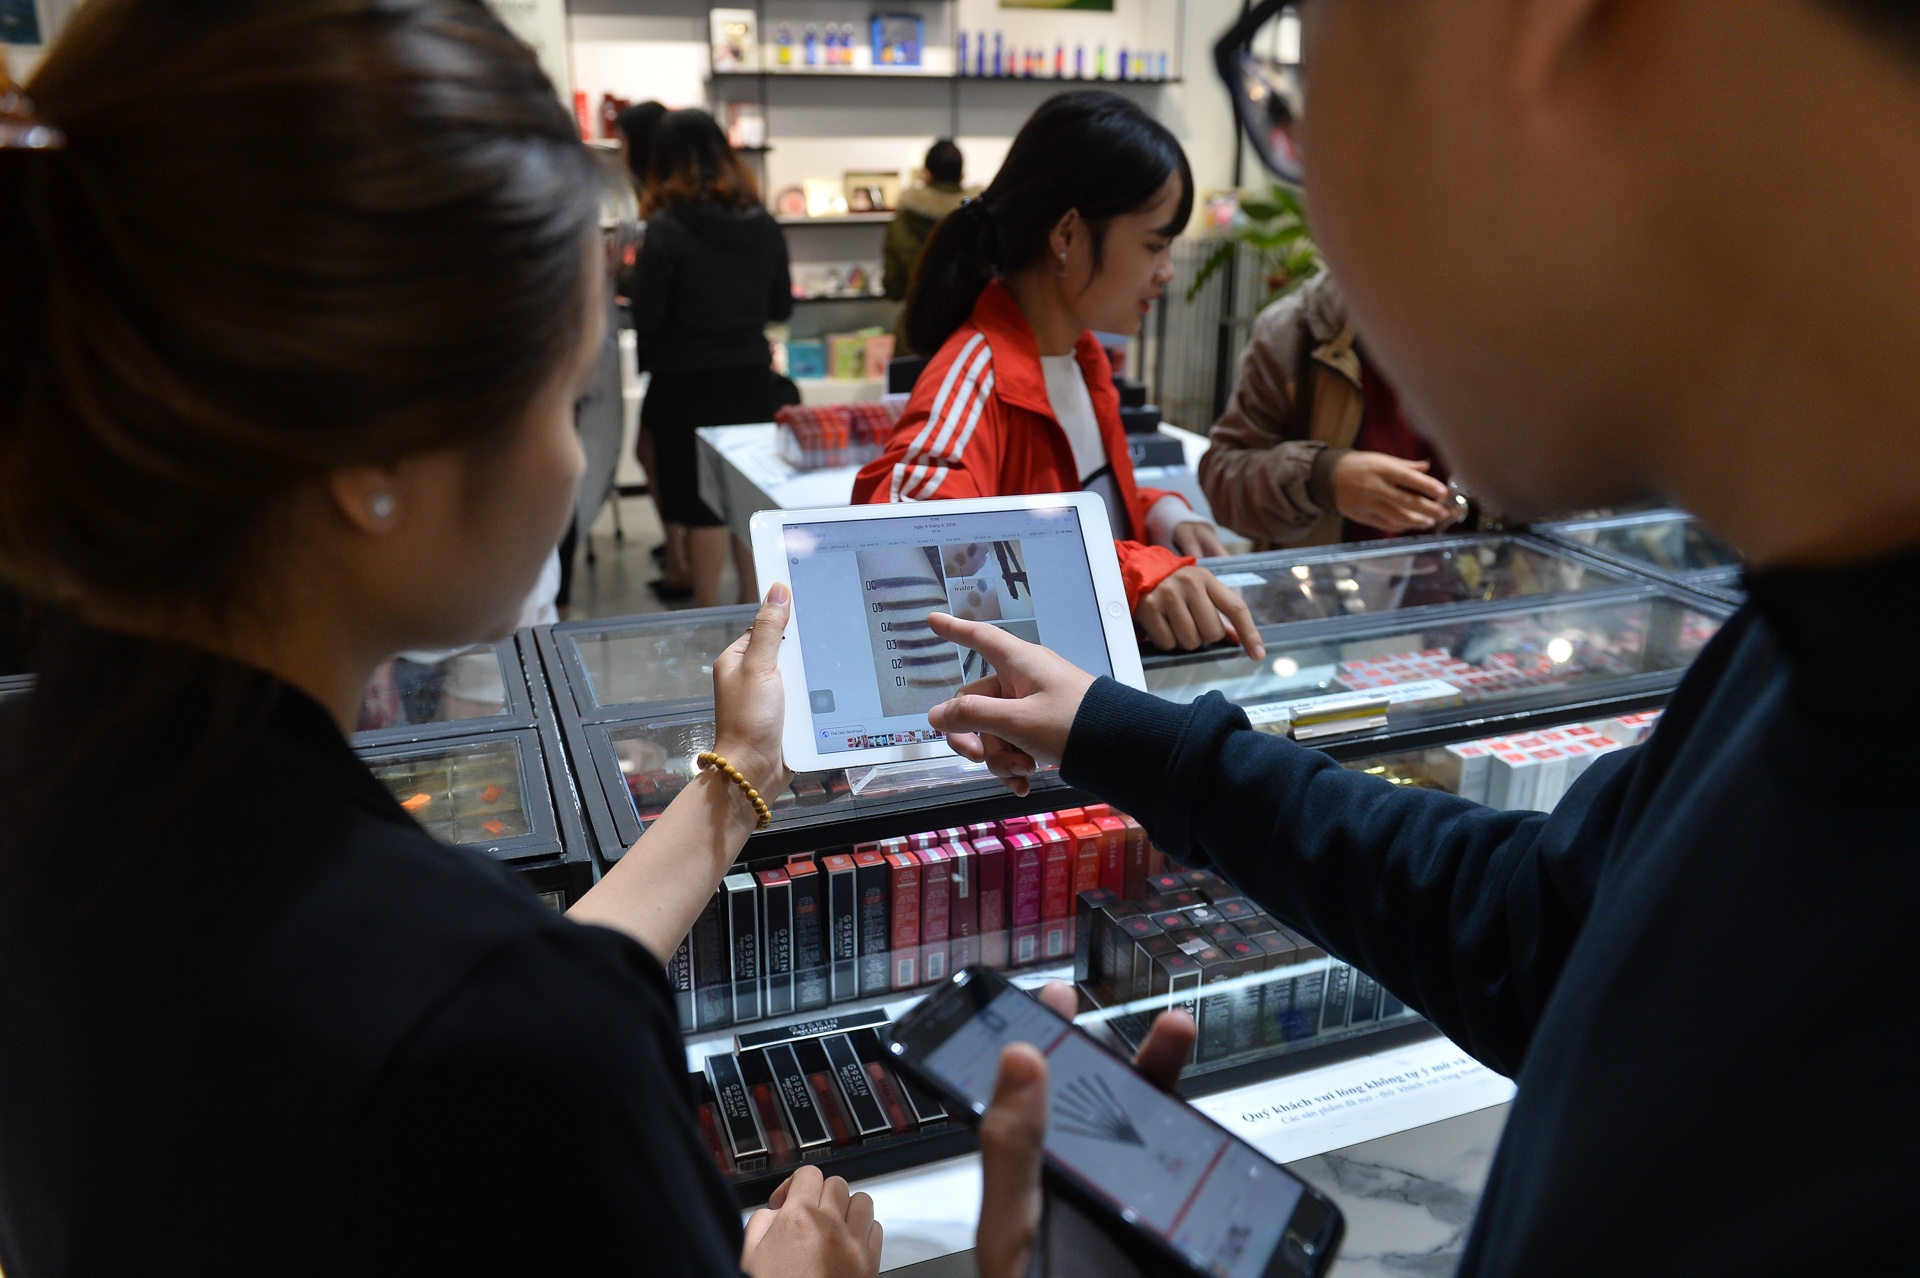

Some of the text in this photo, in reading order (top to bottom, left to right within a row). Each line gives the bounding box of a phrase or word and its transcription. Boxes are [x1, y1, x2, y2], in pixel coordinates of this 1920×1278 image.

[872, 602, 884, 613] 05
[880, 622, 892, 632] 04
[886, 640, 898, 650] 03
[892, 659, 902, 670] 02
[895, 676, 906, 687] 01
[779, 928, 788, 972] G9SKIN
[844, 915, 852, 958] G9SKIN
[679, 946, 689, 990] G9SKIN
[744, 934, 754, 977] G9SKIN
[790, 1074, 810, 1108] G9SKIN
[848, 1064, 869, 1096] G9SKIN
[1242, 1108, 1270, 1122] Quý
[1272, 1098, 1312, 1114] khách
[1314, 1092, 1336, 1102] vui
[1335, 1085, 1366, 1097] lòng
[1364, 1075, 1405, 1090] không
[1405, 1071, 1420, 1080] tự
[730, 1084, 749, 1118] G9SKIN
[1281, 1114, 1300, 1124] Các
[1319, 1103, 1344, 1116] phẩm
